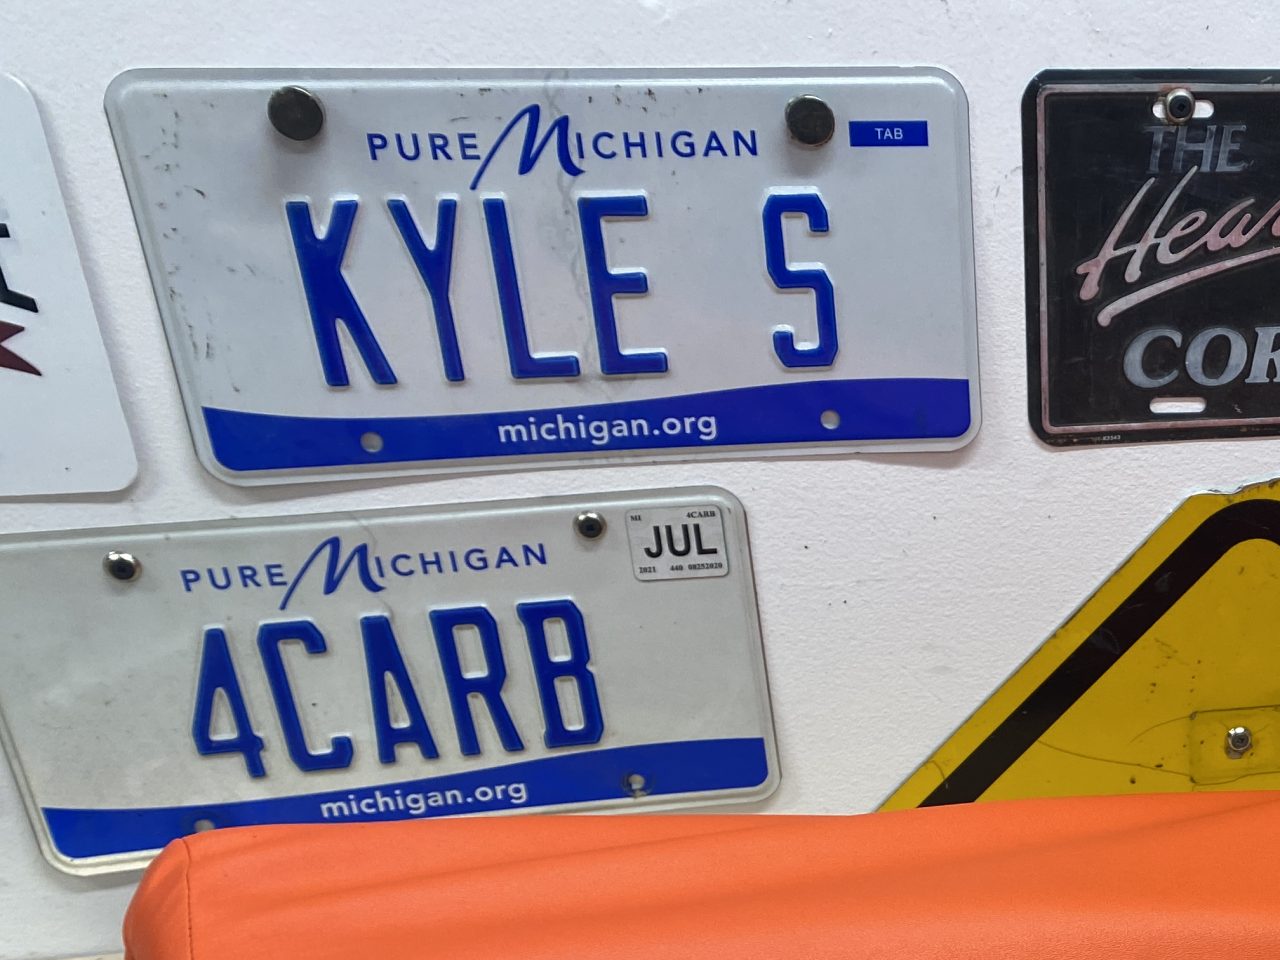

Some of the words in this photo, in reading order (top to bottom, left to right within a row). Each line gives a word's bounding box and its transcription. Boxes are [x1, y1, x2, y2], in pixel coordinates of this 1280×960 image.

[367, 133, 480, 161] PURE
[471, 104, 758, 190] MICHIGAN
[874, 127, 904, 140] TAB
[1142, 125, 1250, 173] THE
[287, 195, 668, 386] KYLE
[762, 193, 839, 368] S
[498, 414, 718, 445] michigan.org
[686, 510, 716, 518] 4CARB
[643, 523, 718, 558] JUL
[181, 562, 288, 592] PURE
[279, 536, 548, 609] MICHIGAN
[194, 599, 603, 777] 4CARB
[320, 783, 527, 818] michigan.org
